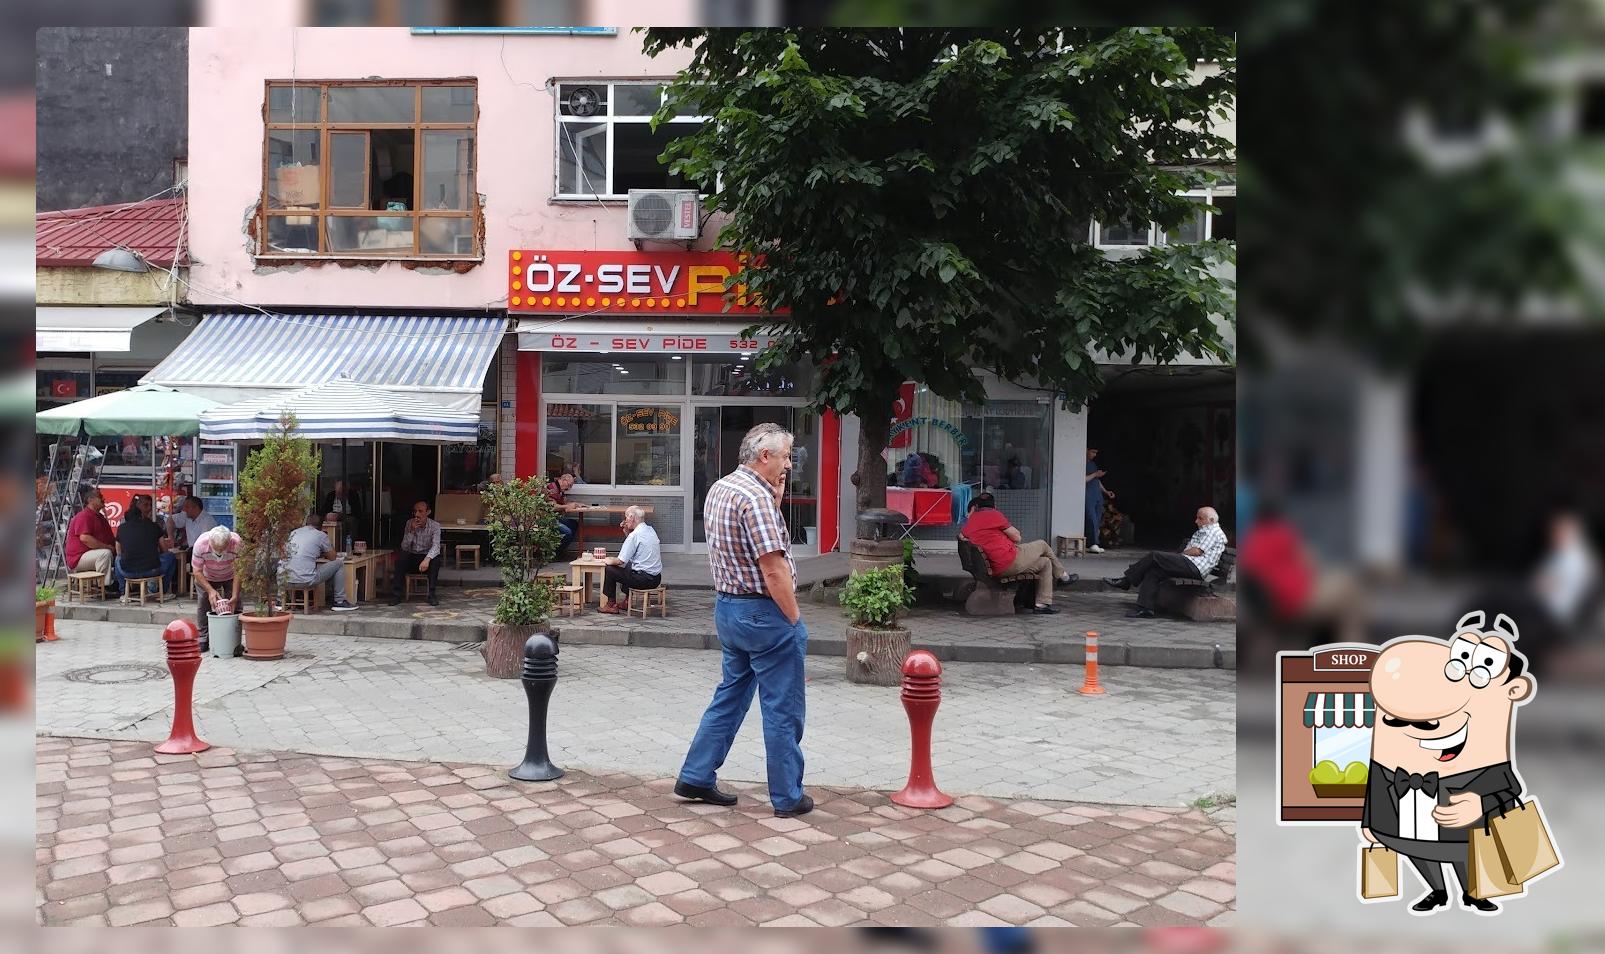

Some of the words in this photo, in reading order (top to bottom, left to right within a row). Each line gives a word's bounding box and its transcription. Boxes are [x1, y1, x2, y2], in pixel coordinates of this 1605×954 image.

[551, 334, 577, 349] ÖZ
[612, 338, 650, 350] SEV
[663, 335, 707, 350] PİDE
[729, 340, 758, 349] 532
